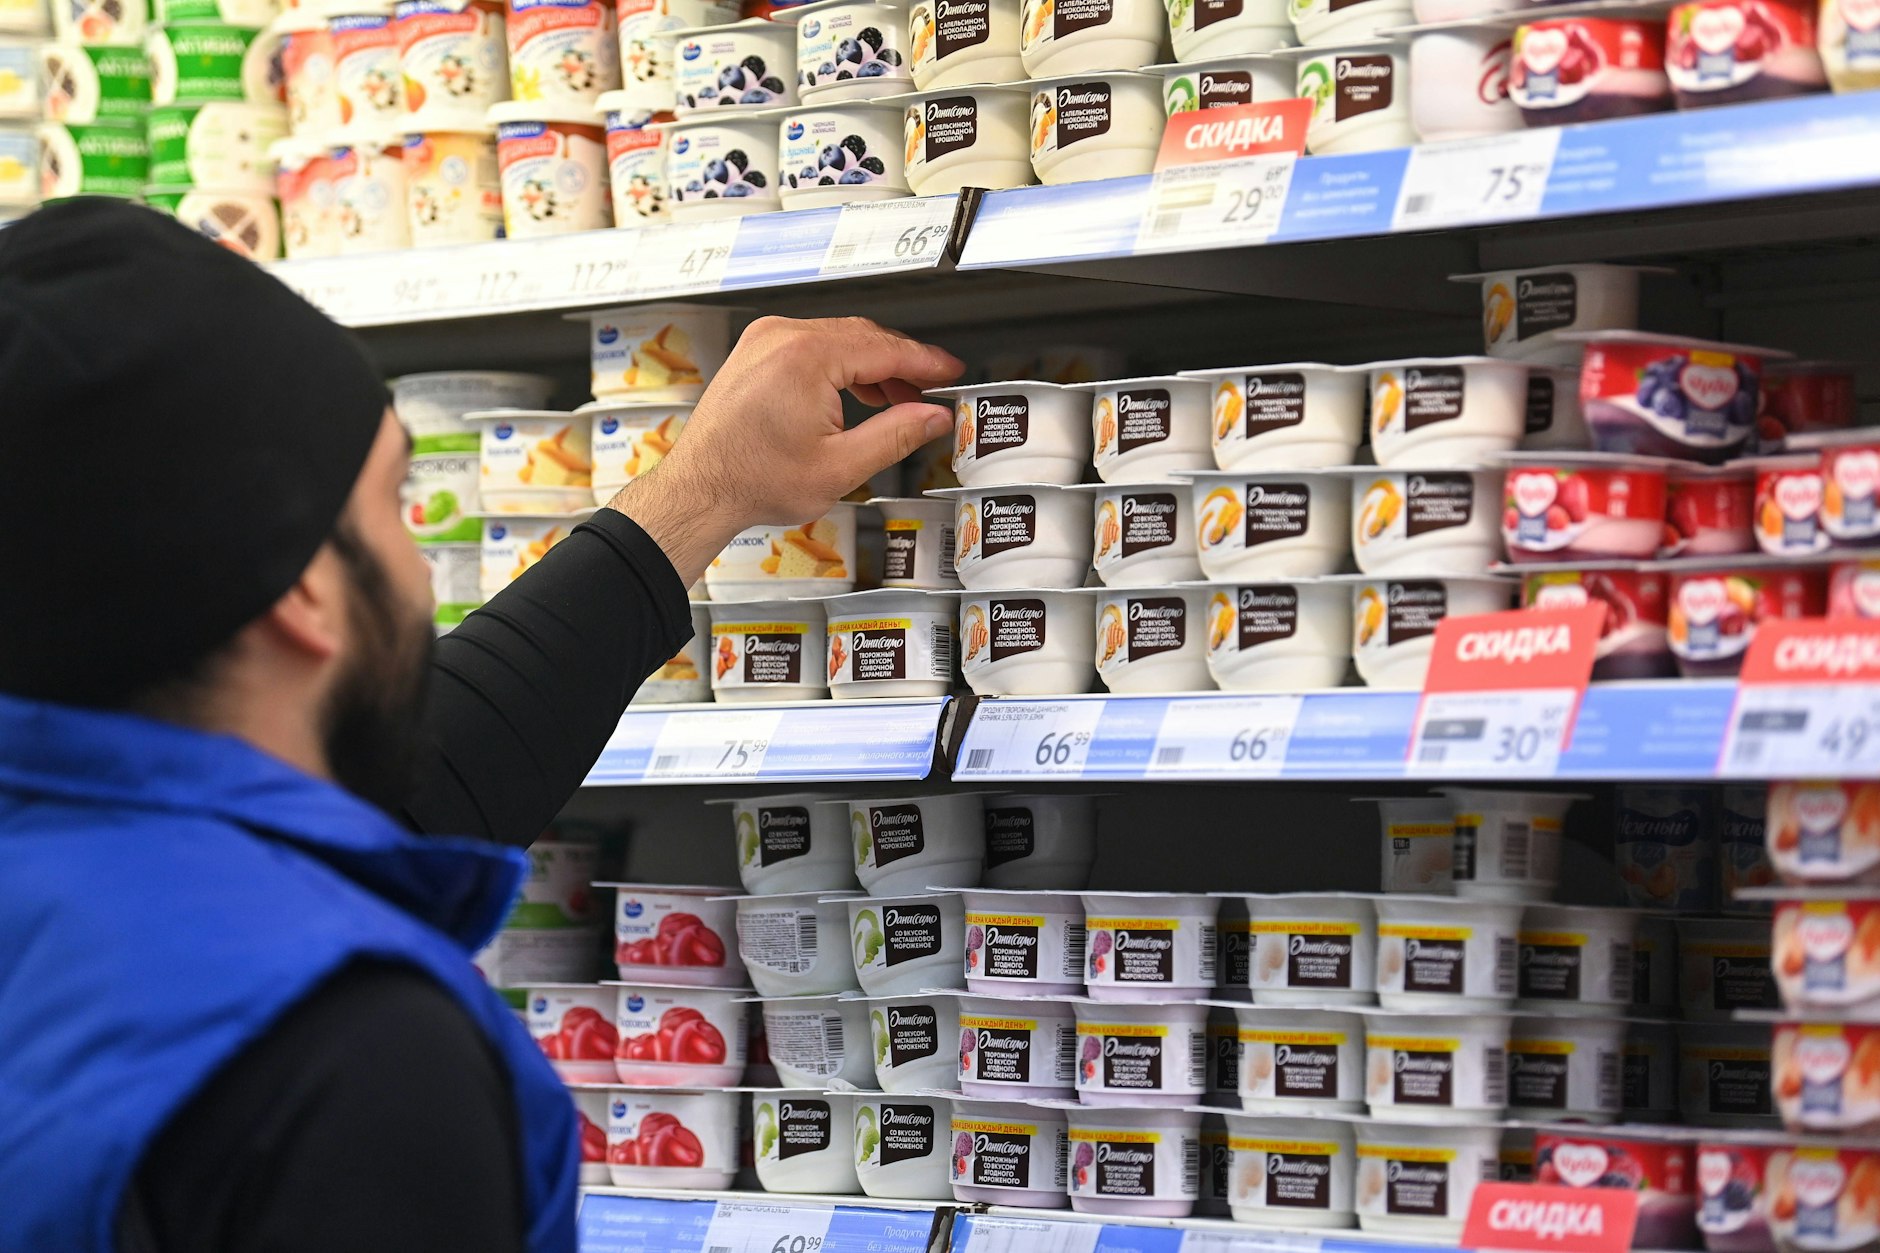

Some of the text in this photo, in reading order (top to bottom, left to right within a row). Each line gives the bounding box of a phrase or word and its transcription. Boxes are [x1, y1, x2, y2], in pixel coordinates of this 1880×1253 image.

[937, 1, 986, 19] Даниссимо
[1062, 4, 1110, 14] ШОКОЛАДНОЙ
[1066, 12, 1098, 20] КРОШКОЙ
[943, 24, 986, 34] ШОКОЛАДНОЙ
[944, 18, 984, 28] АПЕЛЬСИНОМ
[946, 31, 976, 40] КРОШКОЙ
[1201, 76, 1250, 95] Даниссимо
[1059, 89, 1108, 107] Даниссимо
[927, 103, 974, 121] Даниссимо
[1065, 108, 1106, 117] АПЕЛЬСИНОМ
[933, 121, 971, 130] АПЕЛЬСИНОМ
[1063, 114, 1108, 124] ШОКОЛАДНОЙ
[1068, 121, 1097, 130] КРОШКОЙ
[931, 128, 973, 138] ШОКОЛАДНОЙ
[935, 135, 963, 143] КРОШКОЙ
[1184, 115, 1284, 151] СКИДКА
[979, 400, 1026, 418] Даниссимо
[1120, 395, 1169, 413] Даниссимо
[984, 423, 1018, 431] МОРОЖЕНОГО
[1248, 486, 1307, 507] Даниссимо
[984, 500, 1033, 518] Даниссимо
[1124, 498, 1175, 516] Даниссимо
[992, 604, 1043, 621] Даниссимо
[852, 620, 901, 630] КАЖДЫЙ ДЕНЬ!
[745, 635, 799, 654] Даниссимо
[853, 633, 904, 651] Даниссимо
[1456, 624, 1571, 663] СКИДКА
[859, 650, 895, 658] ТВОРОЖНЫЙ
[1773, 633, 1880, 676] СКИДК
[1035, 732, 1091, 765] 66 99
[872, 811, 918, 827] Даниссимо
[877, 834, 917, 843] ФИСТАШКОВОЕ
[880, 841, 914, 849] МОРОЖЕНОЕ
[886, 909, 937, 927] Даниссимо
[985, 917, 1034, 926] КАЖДЫЙ ДЕНЬ!
[890, 935, 935, 943] ФИСТАШКОВОЕ
[986, 927, 1037, 947] Даниссимо
[1116, 931, 1171, 951] Даниссимо
[893, 941, 932, 949] МОРОЖЕНОЕ
[992, 948, 1027, 956] ТВОРОЖНЫЙ
[990, 968, 1029, 976] МОРОЖЕНОГО
[890, 1010, 933, 1027] Даниссимо
[978, 1019, 1026, 1029] КАЖДЫЙ ДЕНЬ!
[894, 1036, 931, 1044] ФИСТАШКОВОЕ
[979, 1030, 1028, 1050] Даниссимо
[1104, 1037, 1160, 1057] Даниссимо
[984, 1051, 1019, 1059] ТВОРОЖНЫЙ
[982, 1071, 1021, 1079] МОРОЖЕНОГО
[781, 1103, 828, 1121] Даниссимо
[882, 1108, 931, 1126] Даниссимо
[978, 1123, 1002, 1132] КАЖДЫЙ
[975, 1134, 1028, 1155] Даниссимо
[981, 1155, 1018, 1164] ТВОРОЖНЫЙ
[1097, 1143, 1153, 1163] Даниссимо
[992, 1163, 1016, 1171] ВКУСОМ
[1268, 1154, 1328, 1175] Даниссимо
[983, 1169, 1014, 1177] ЯГОДНОГО
[978, 1176, 1020, 1184] МОРОЖЕНОГО
[1488, 1199, 1603, 1241] СКИДКА
[884, 1226, 927, 1239] Продукты
[807, 1236, 822, 1250] 99
